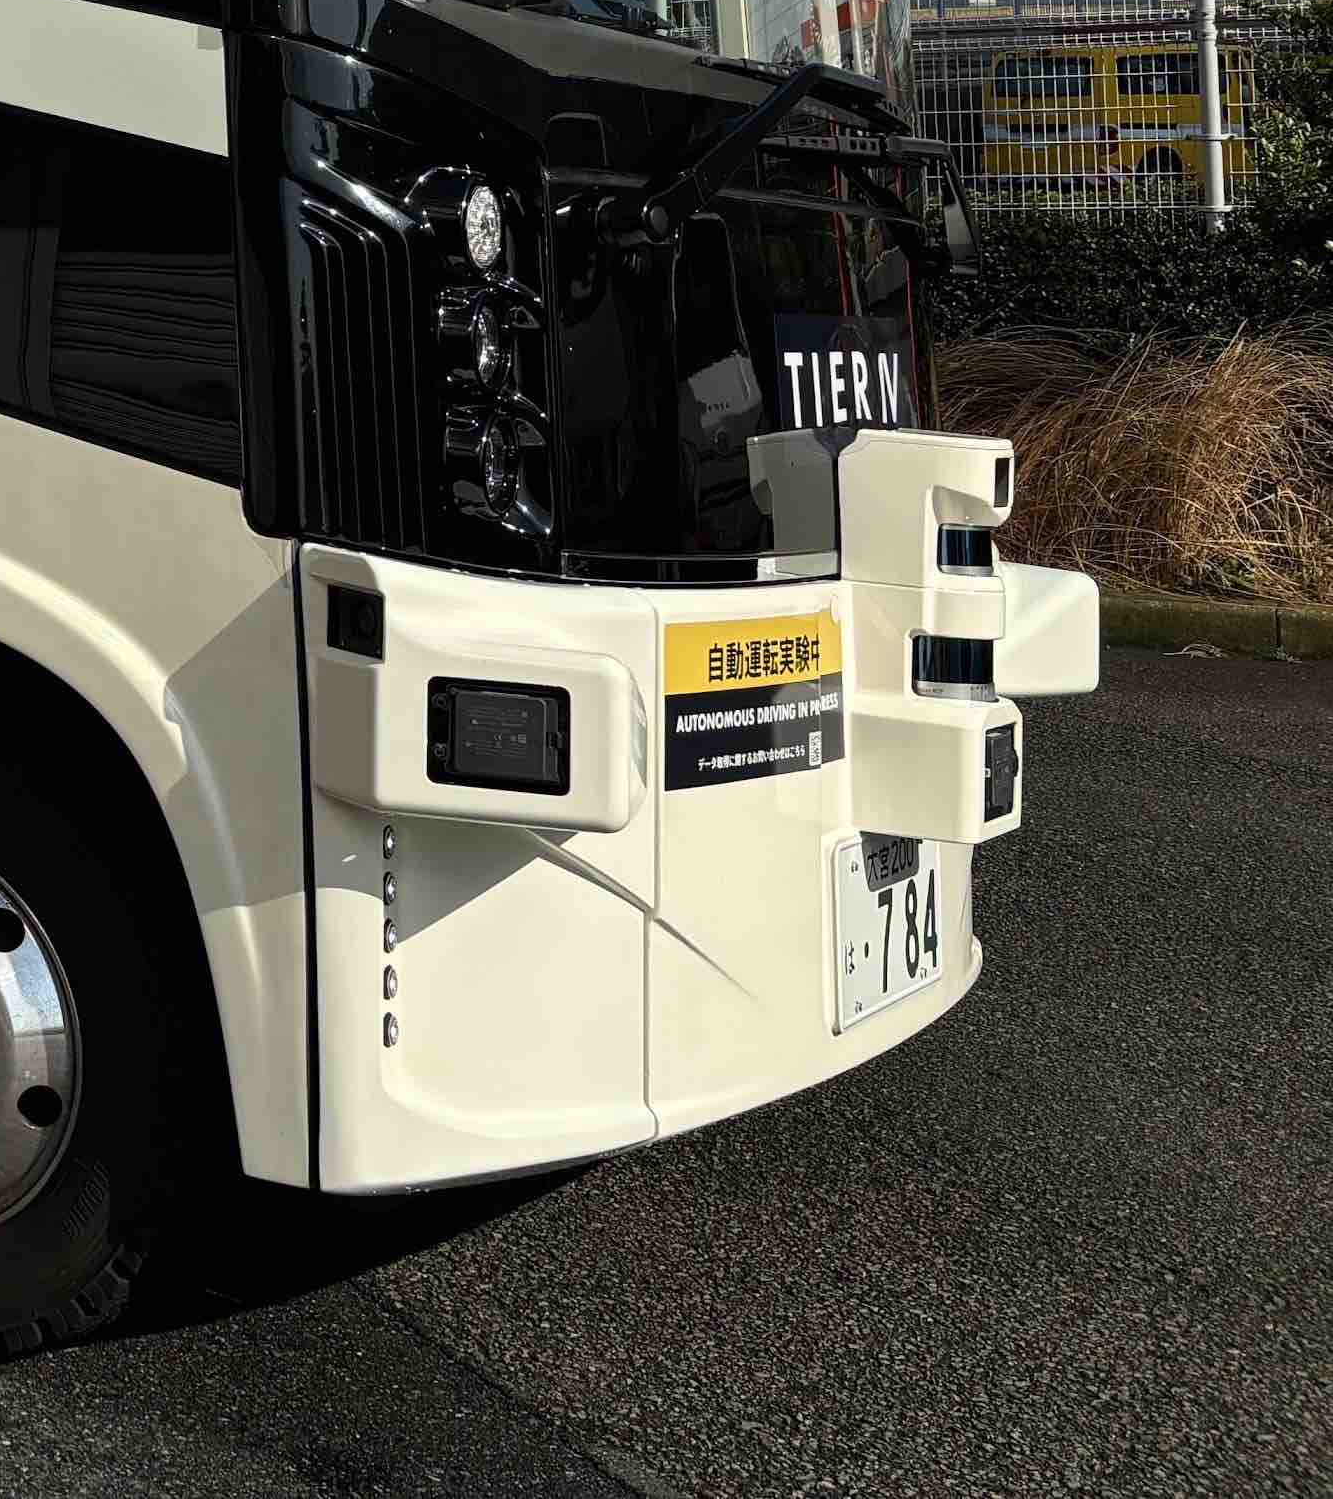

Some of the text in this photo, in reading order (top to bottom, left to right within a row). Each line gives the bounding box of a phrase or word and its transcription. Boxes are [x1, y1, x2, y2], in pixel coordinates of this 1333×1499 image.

[784, 351, 873, 429] TIER
[708, 632, 820, 683] 自動運転実験中
[676, 708, 755, 733] AUTONOMOUS
[757, 701, 796, 724] DRIVING
[798, 700, 809, 718] IN
